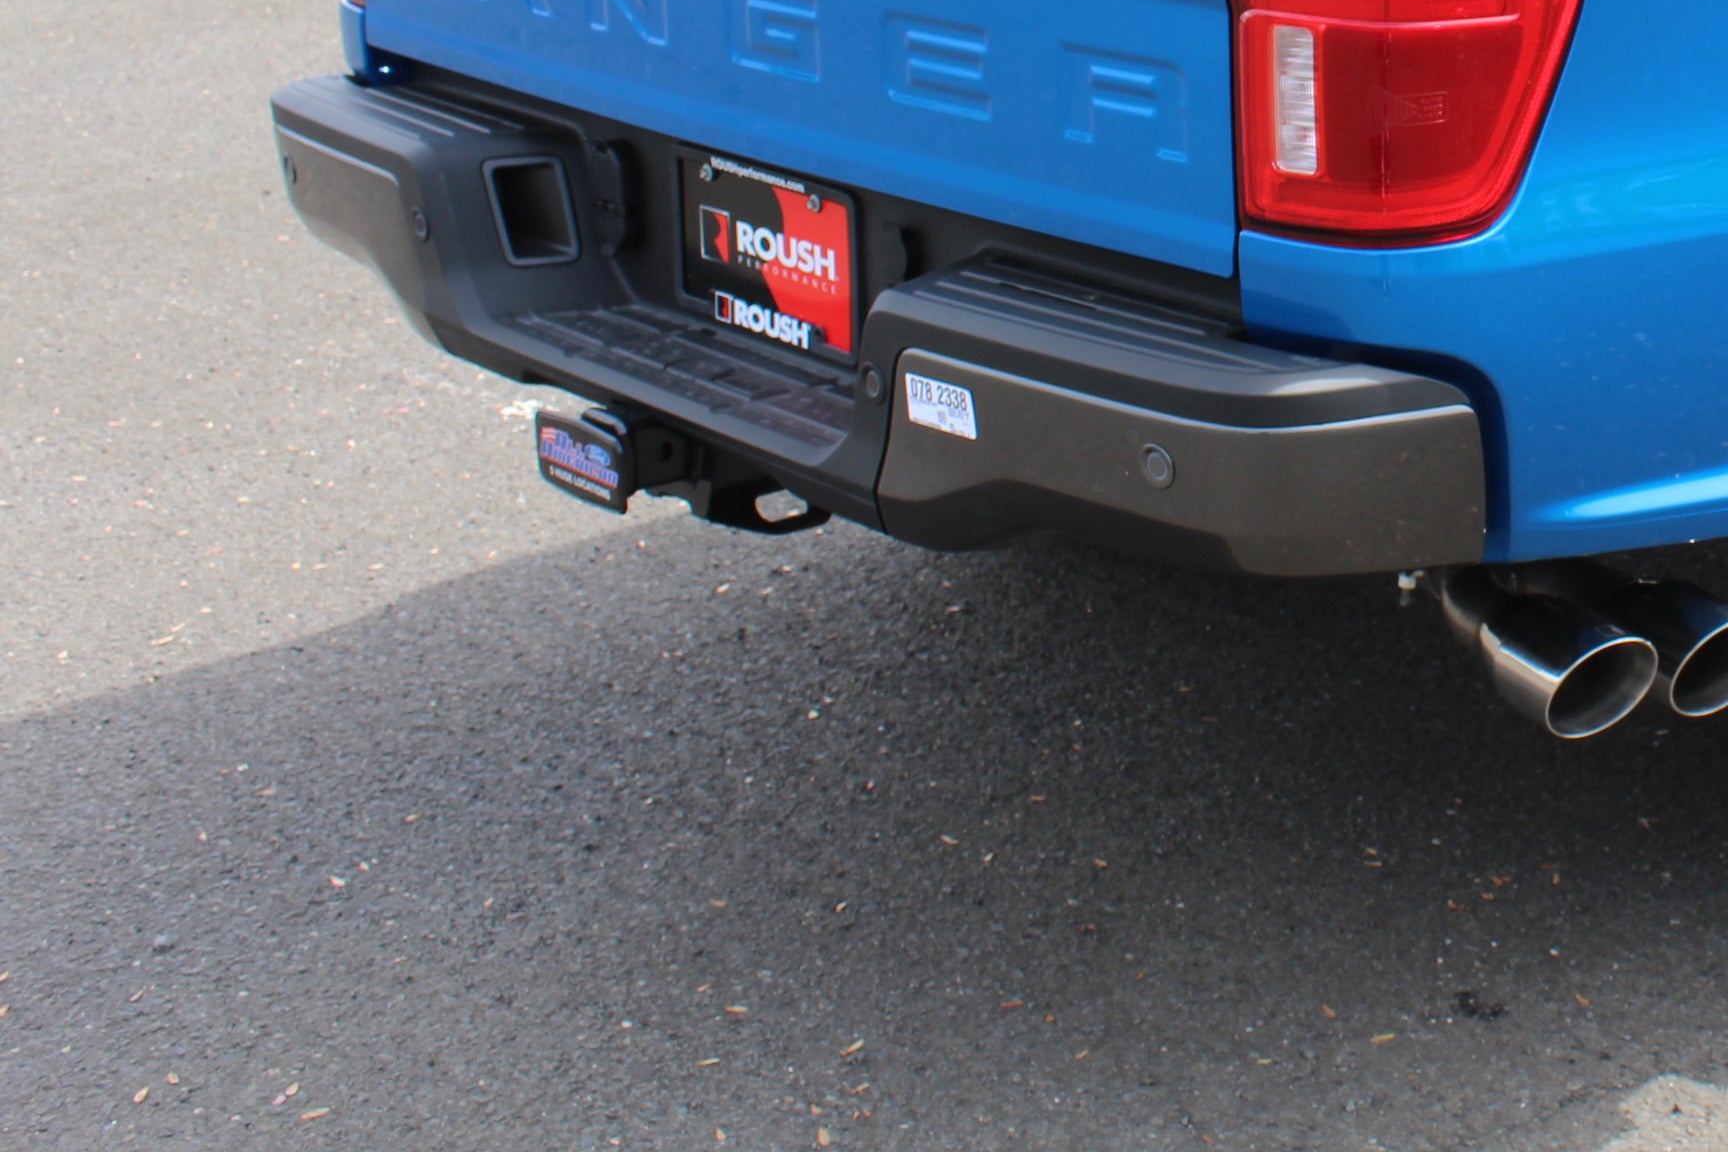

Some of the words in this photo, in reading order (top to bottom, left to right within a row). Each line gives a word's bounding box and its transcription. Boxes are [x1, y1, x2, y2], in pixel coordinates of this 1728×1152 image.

[736, 220, 837, 282] ROUSH
[738, 254, 838, 296] PERFORMANCE
[733, 298, 811, 350] ROUSH
[936, 385, 968, 412] 2338
